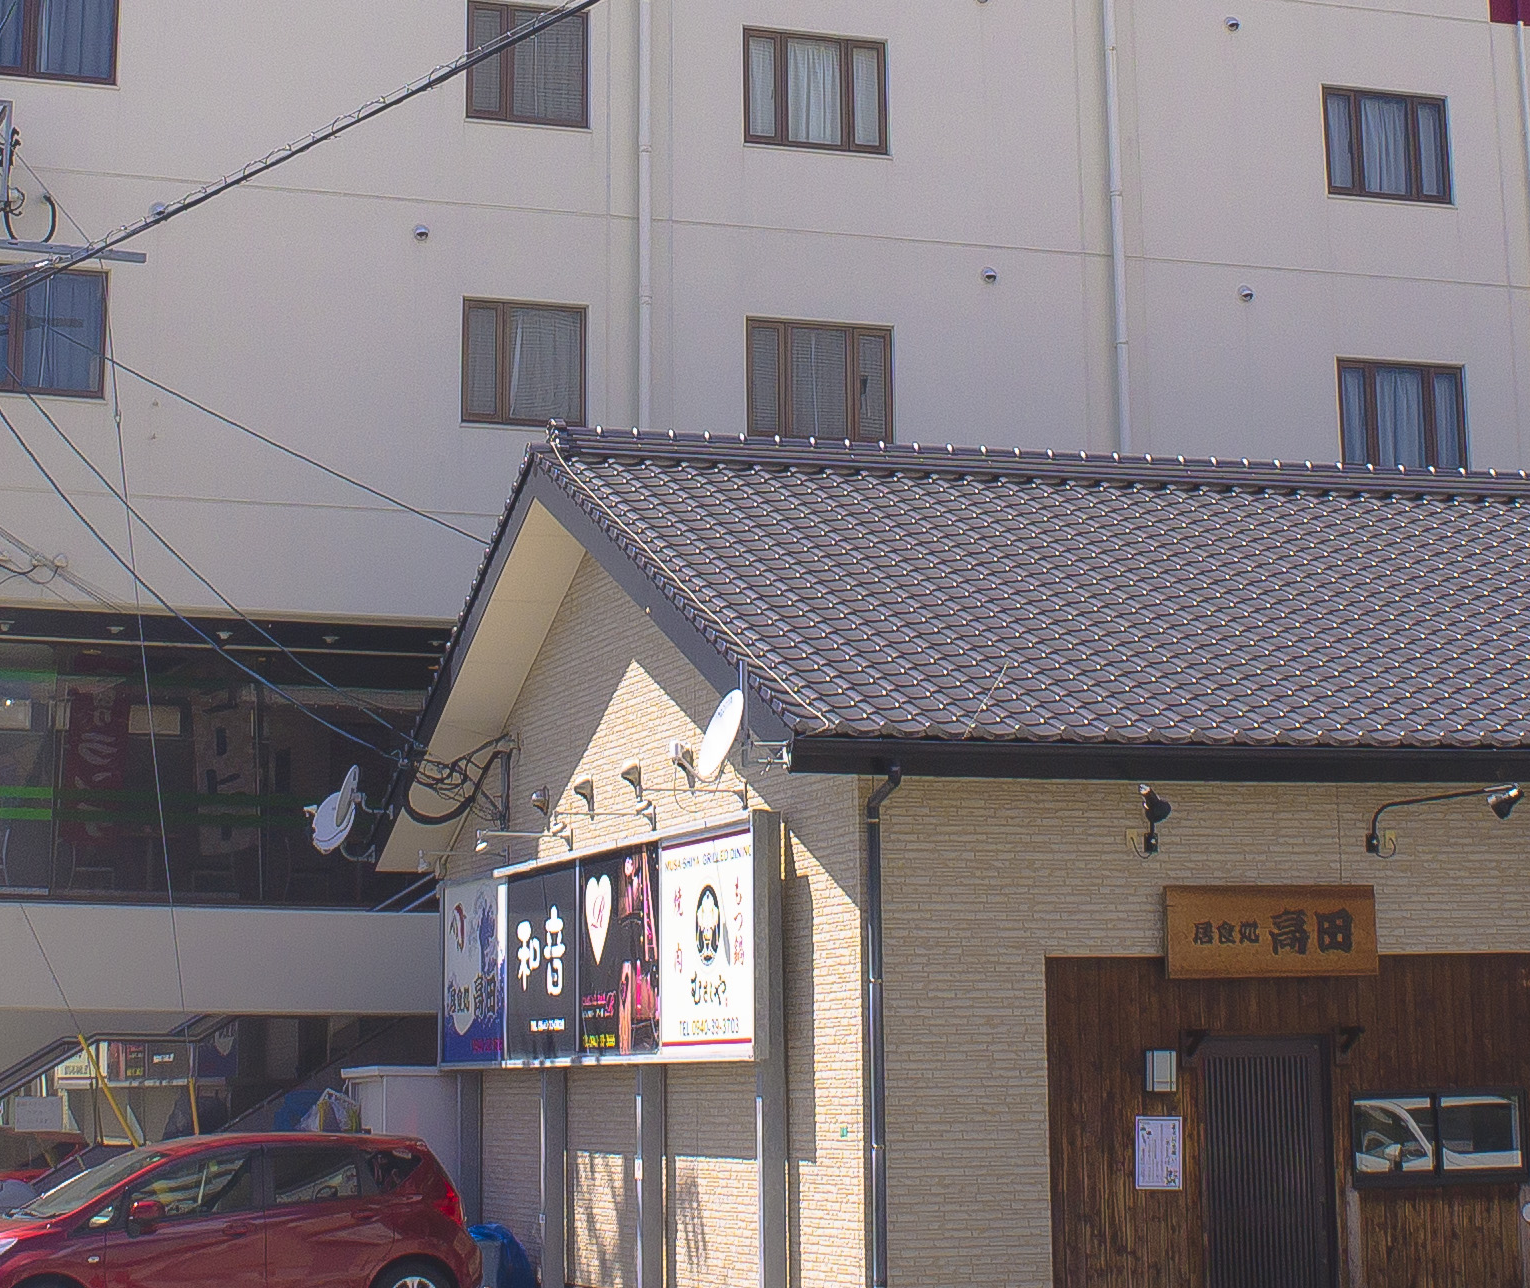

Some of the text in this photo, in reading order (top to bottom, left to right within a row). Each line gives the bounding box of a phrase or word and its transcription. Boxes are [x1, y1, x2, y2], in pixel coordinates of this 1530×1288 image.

[517, 904, 566, 997] 和音
[1192, 919, 1261, 946] 居食処
[690, 970, 727, 1007] むさしや
